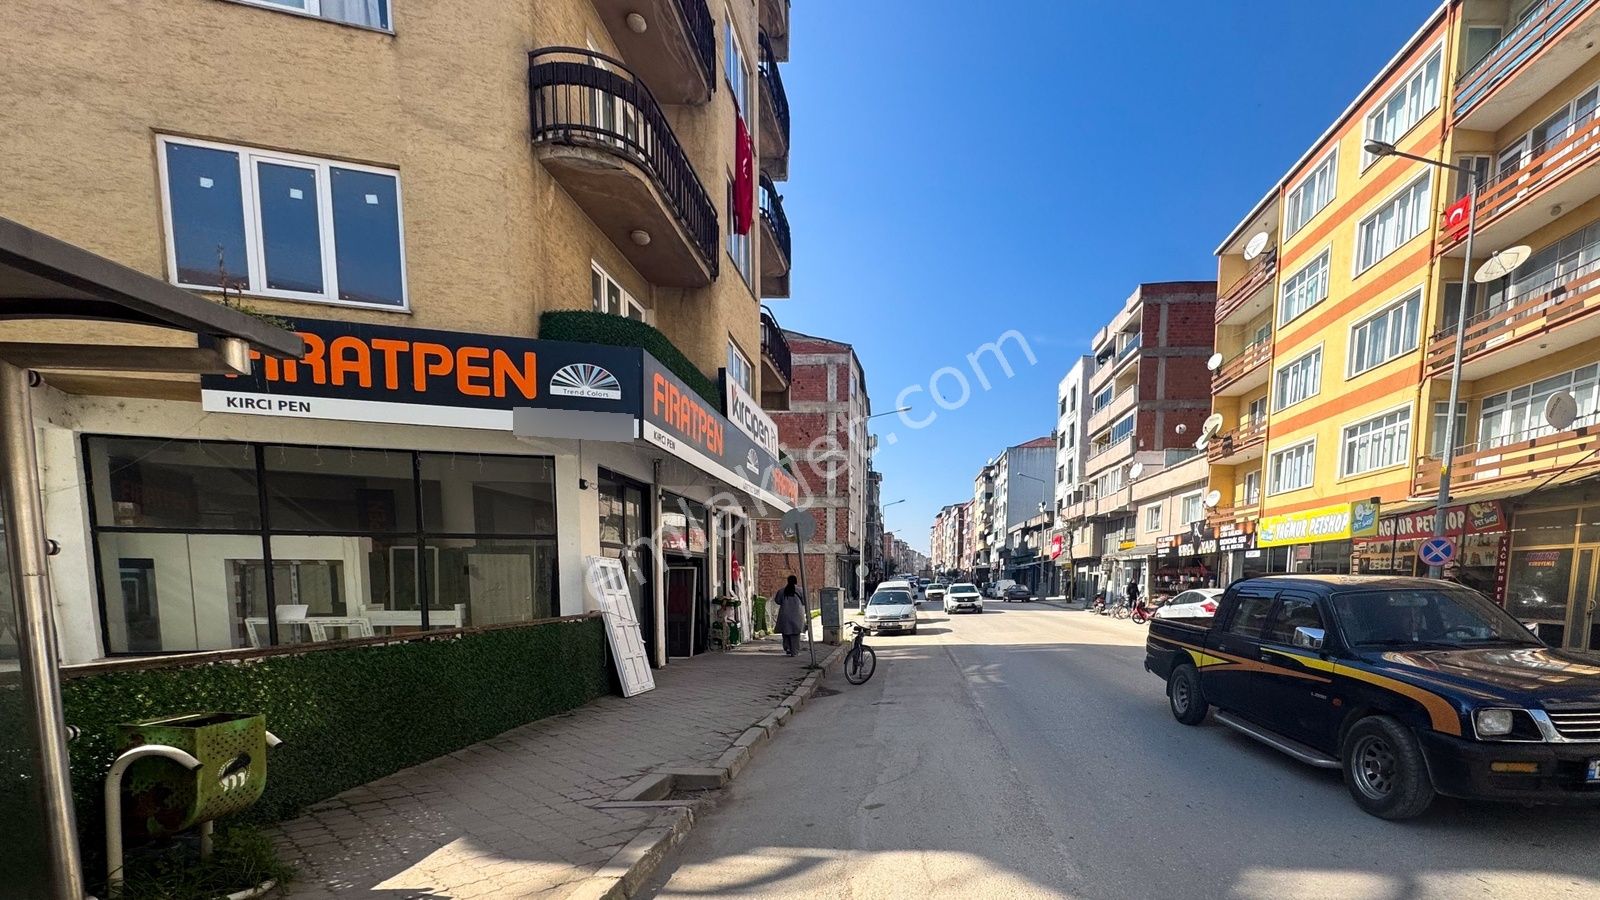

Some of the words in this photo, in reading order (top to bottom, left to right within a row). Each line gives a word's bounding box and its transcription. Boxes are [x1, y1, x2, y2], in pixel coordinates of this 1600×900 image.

[563, 388, 585, 396] Trend
[586, 389, 609, 398] Colors
[226, 396, 272, 410] KIRCI
[278, 400, 311, 413] PEN
[653, 372, 724, 457] FIRATPEN
[666, 437, 676, 451] PEN
